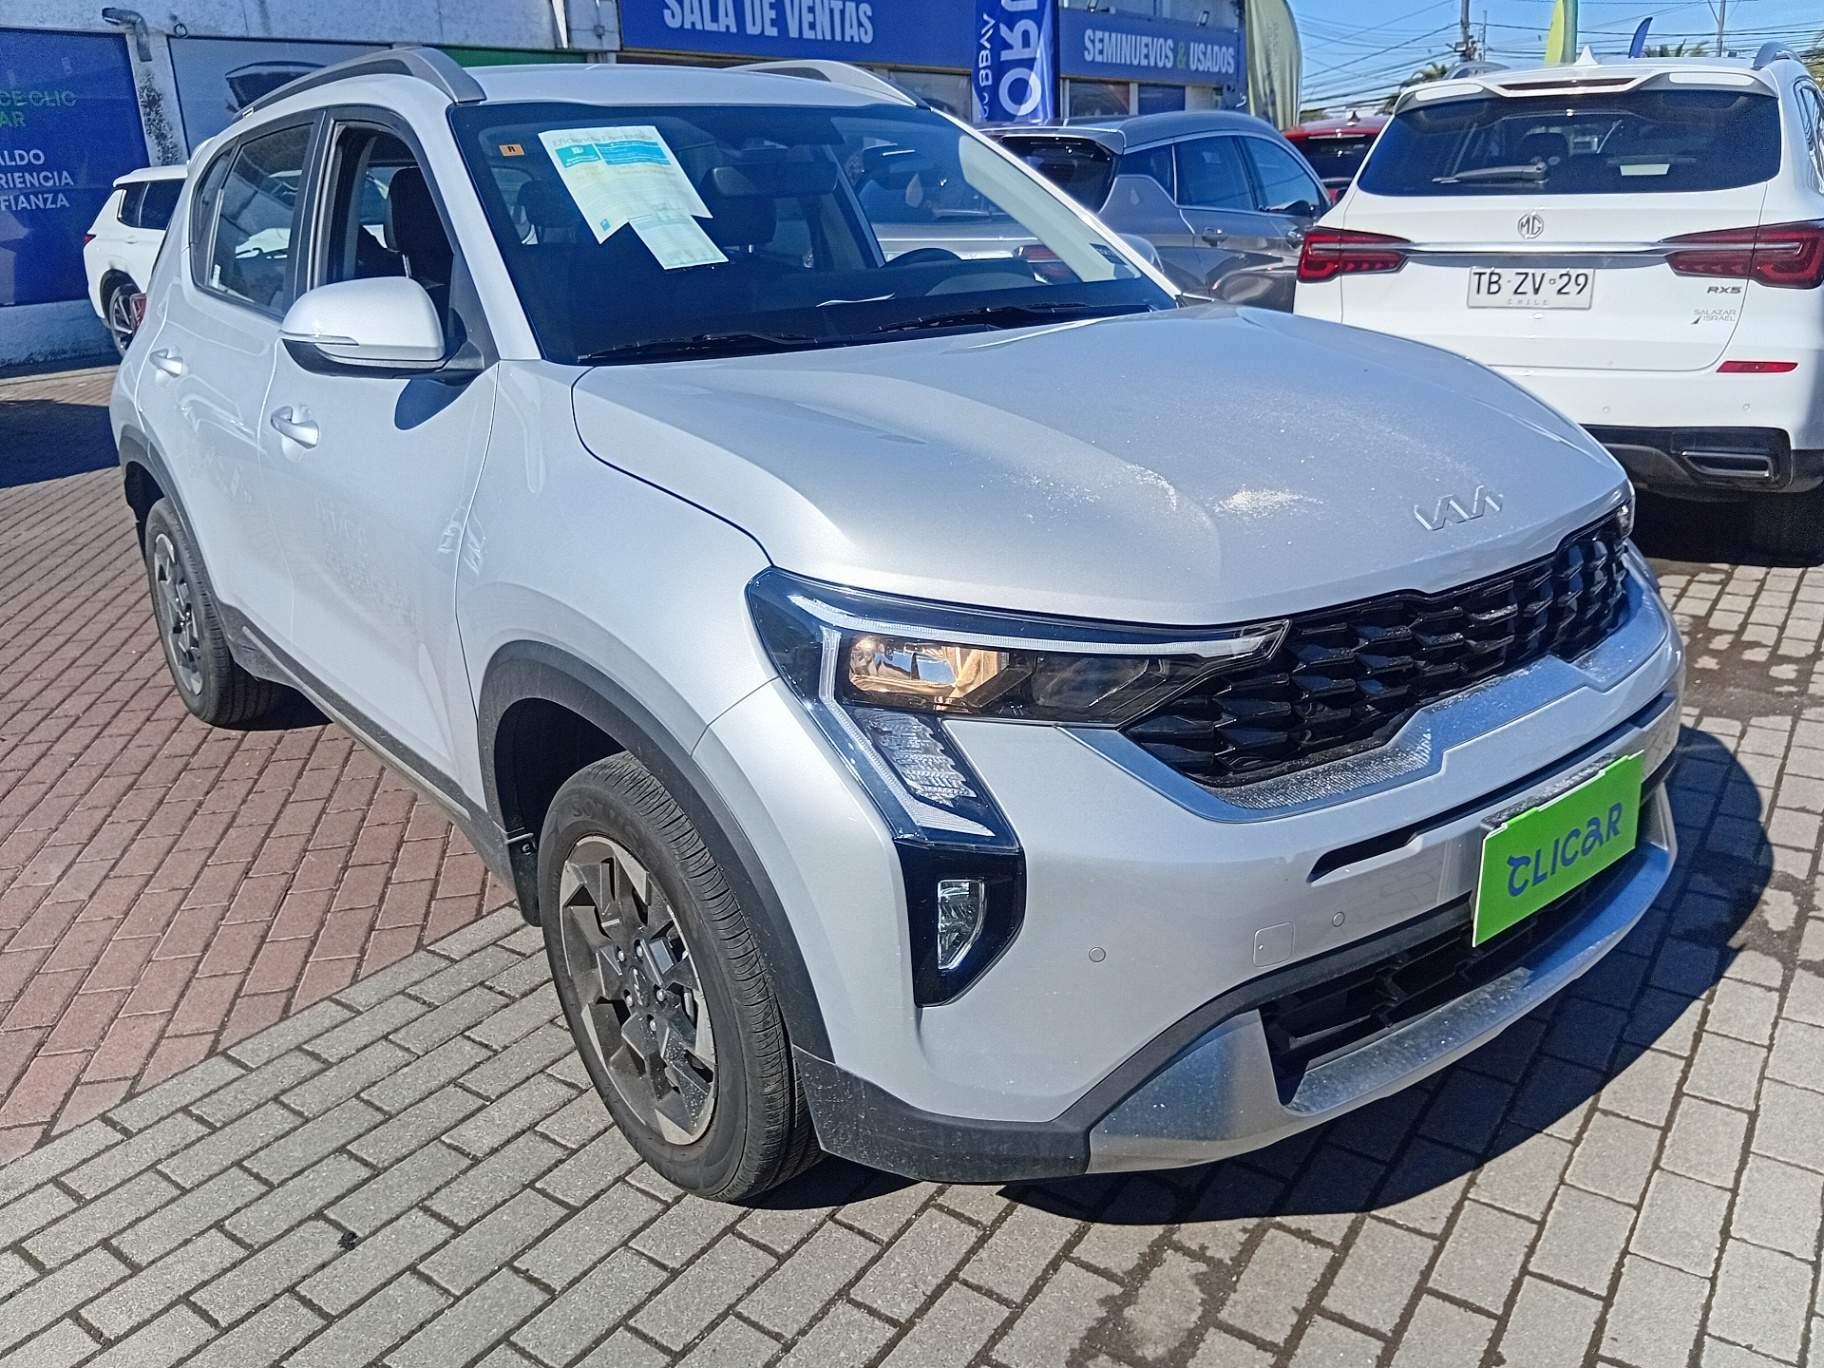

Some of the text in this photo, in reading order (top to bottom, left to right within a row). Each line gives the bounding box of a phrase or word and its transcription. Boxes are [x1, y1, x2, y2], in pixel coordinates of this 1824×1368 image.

[664, 0, 874, 44] SALA DE VENTAS
[1084, 29, 1174, 69] SEMINUEVOS
[1176, 41, 1188, 70] &
[1189, 42, 1235, 75] USADOS
[1519, 214, 1542, 236] MG
[1706, 286, 1742, 295] RX5
